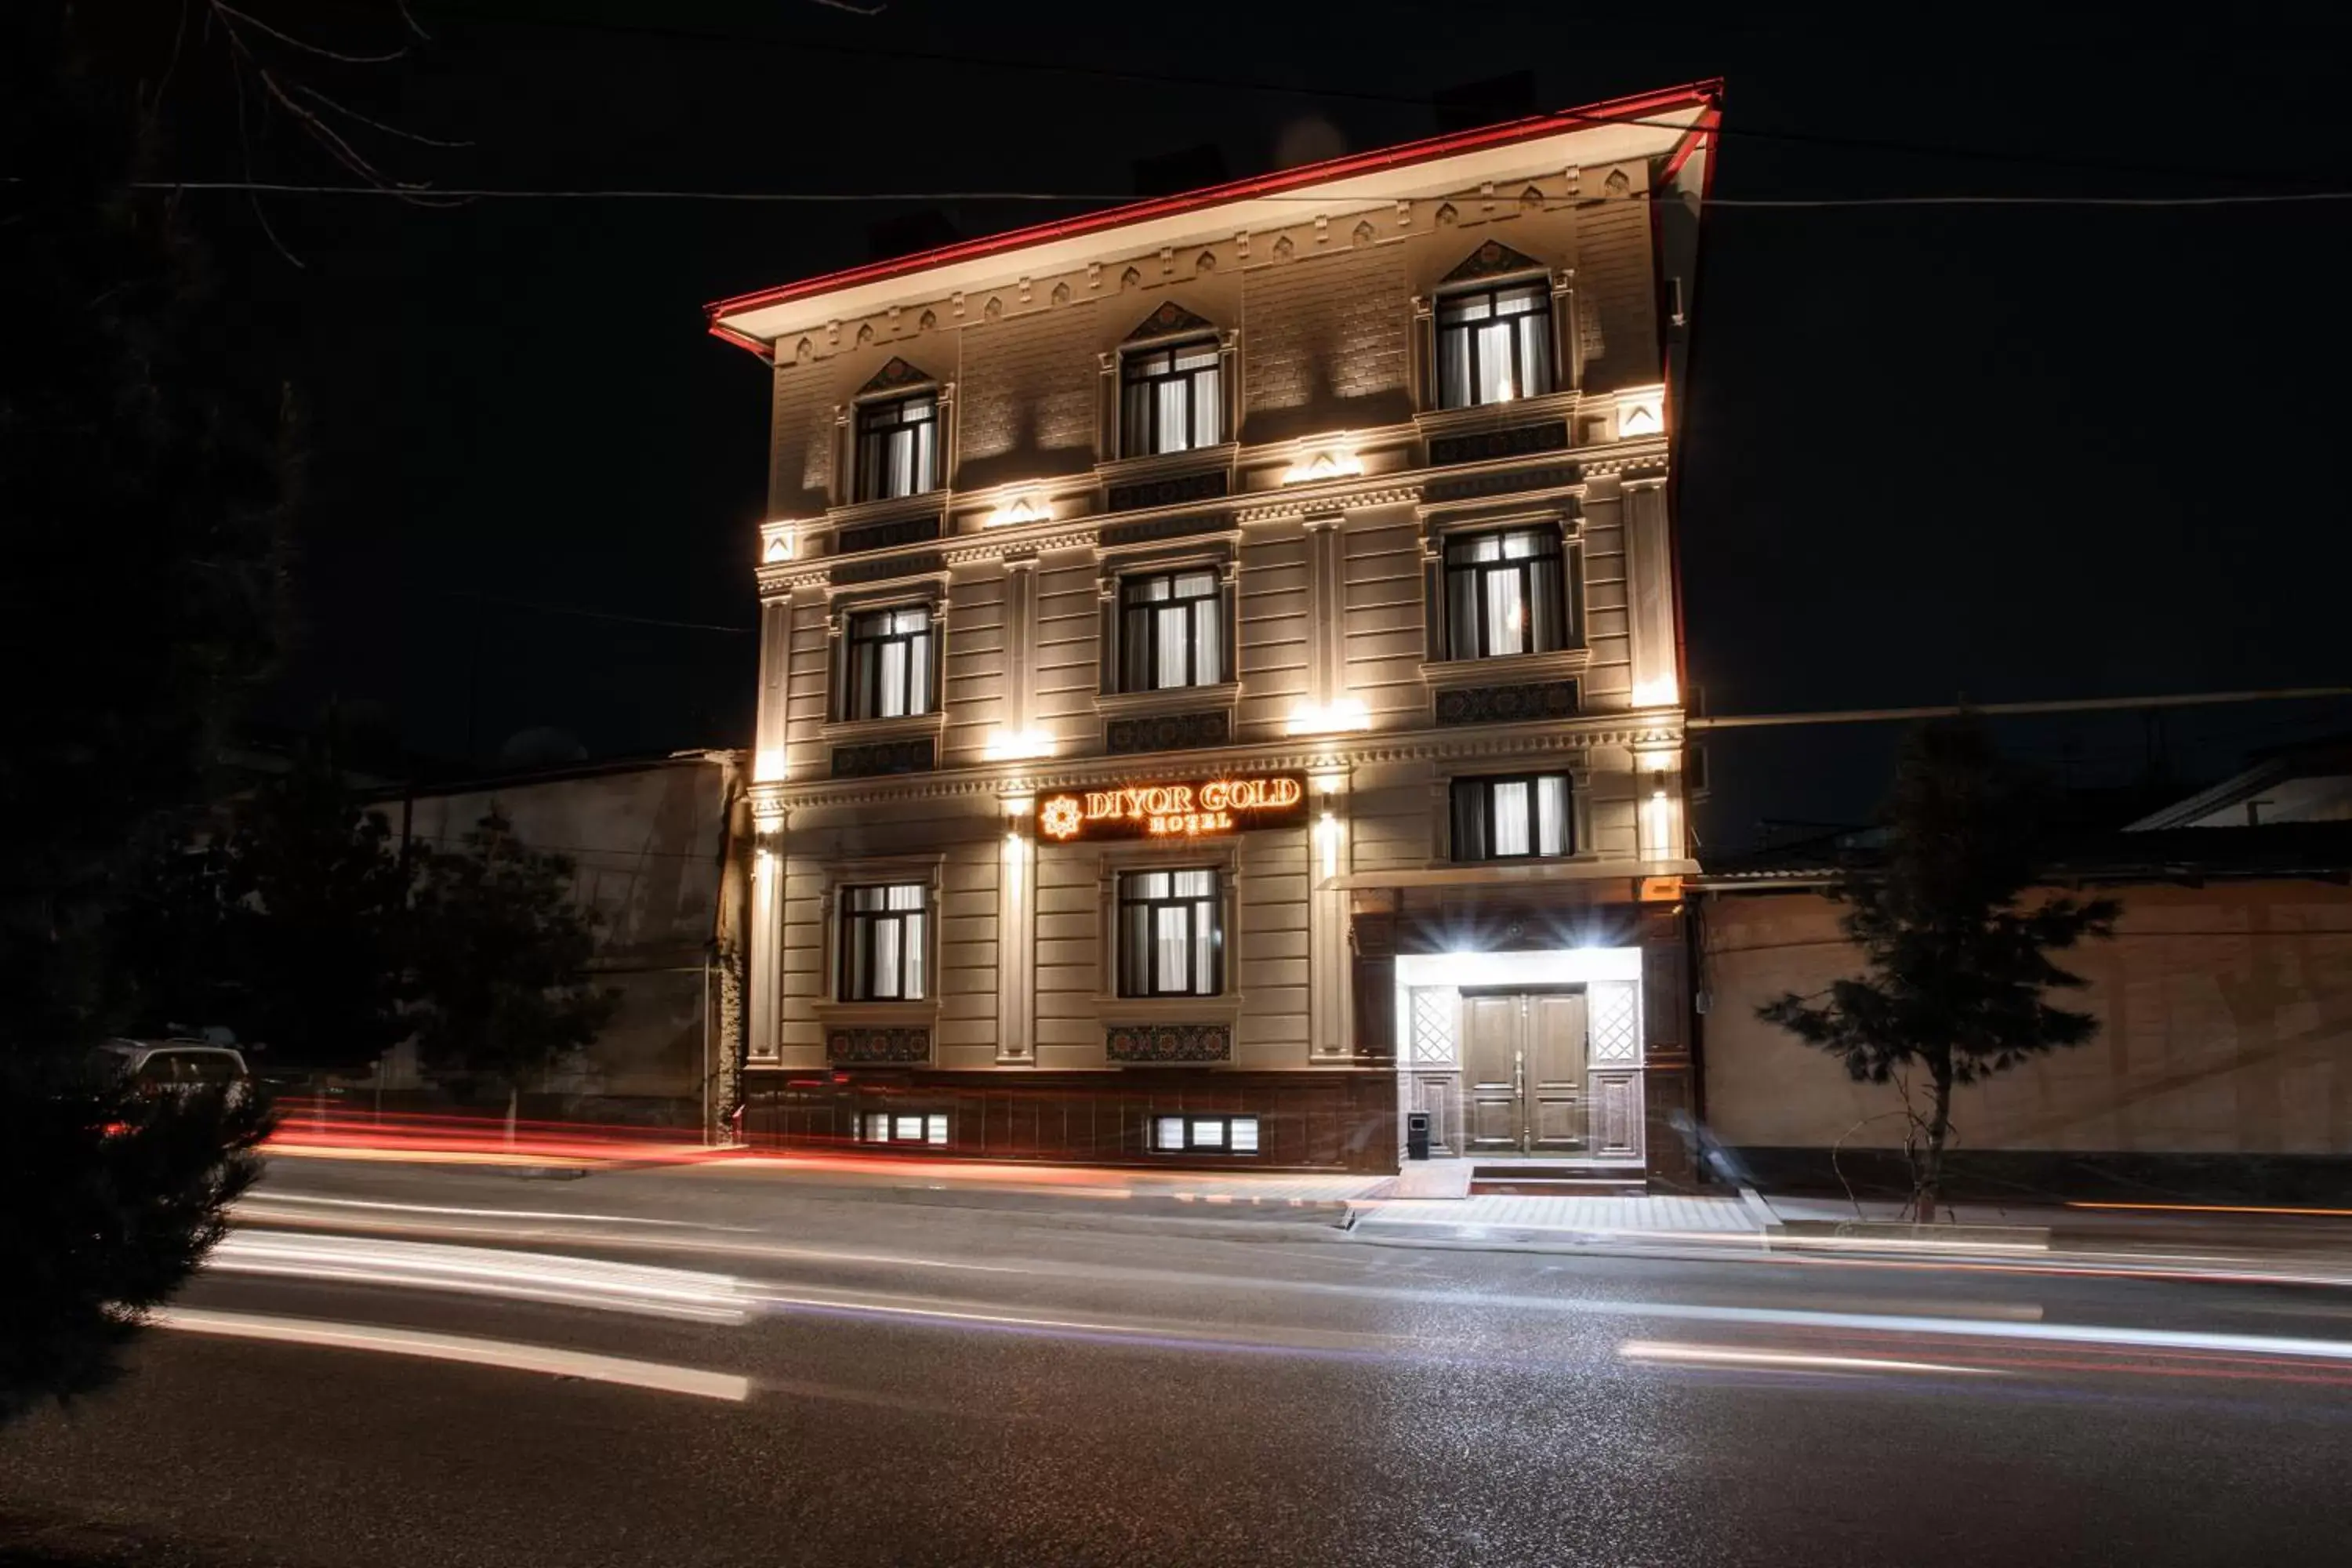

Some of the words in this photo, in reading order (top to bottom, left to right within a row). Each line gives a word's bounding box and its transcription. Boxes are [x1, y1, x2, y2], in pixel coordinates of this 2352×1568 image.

[1085, 786, 1194, 819] DIYOR
[1200, 778, 1301, 809] GOLD
[1149, 812, 1232, 833] HOTEL
